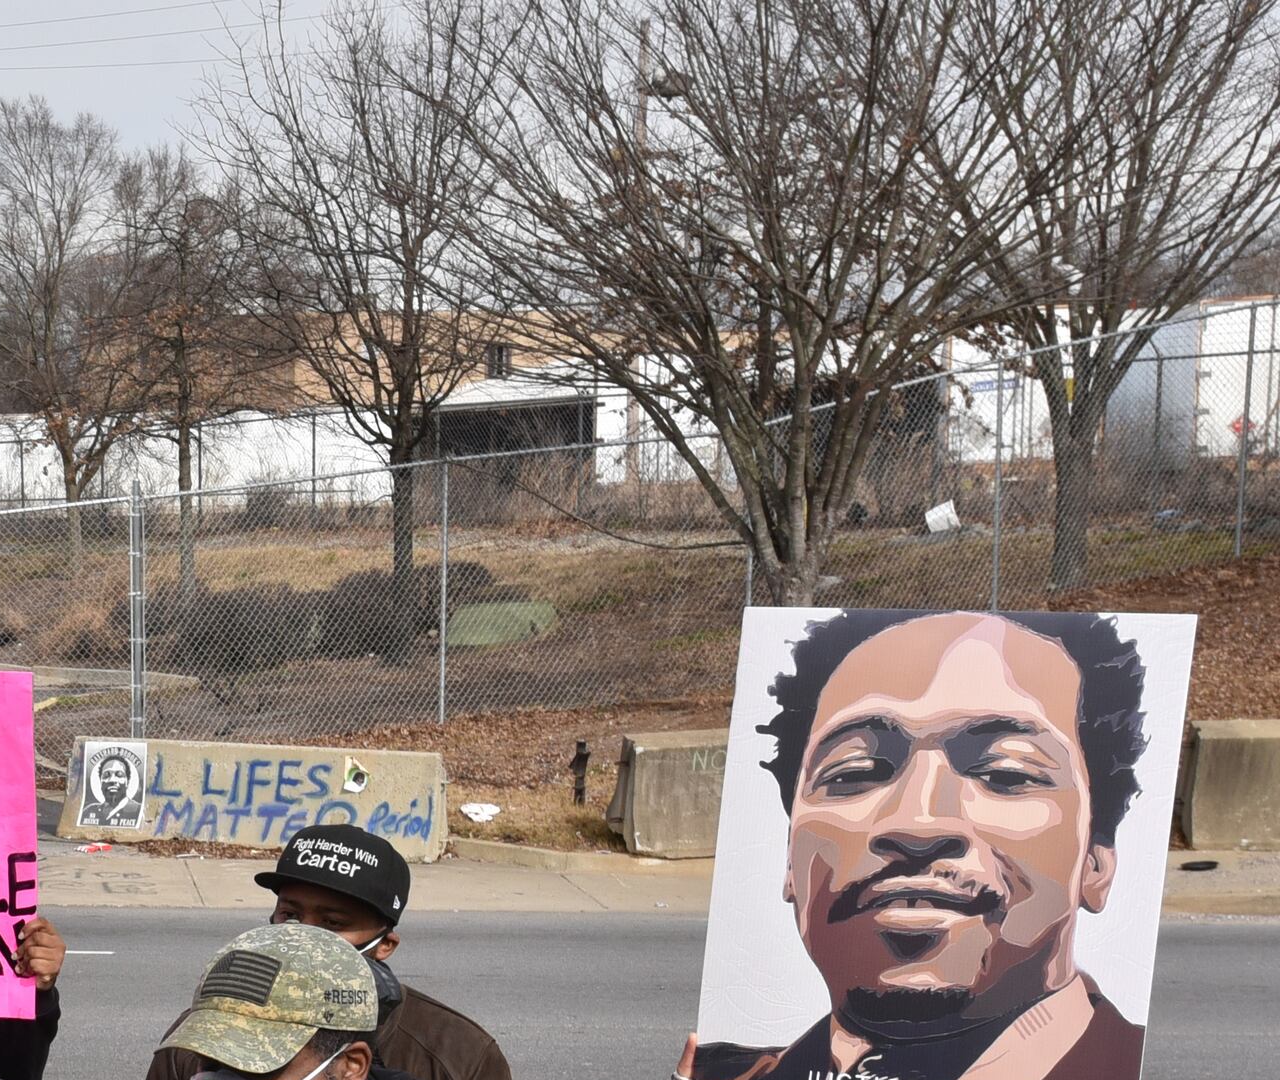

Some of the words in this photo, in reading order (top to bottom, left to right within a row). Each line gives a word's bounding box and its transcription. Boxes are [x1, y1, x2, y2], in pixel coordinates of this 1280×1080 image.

[293, 838, 316, 852] Fight
[314, 838, 353, 856] Harder
[354, 848, 378, 868] With
[296, 849, 361, 878] Carter
[324, 989, 368, 1006] #RESIST
